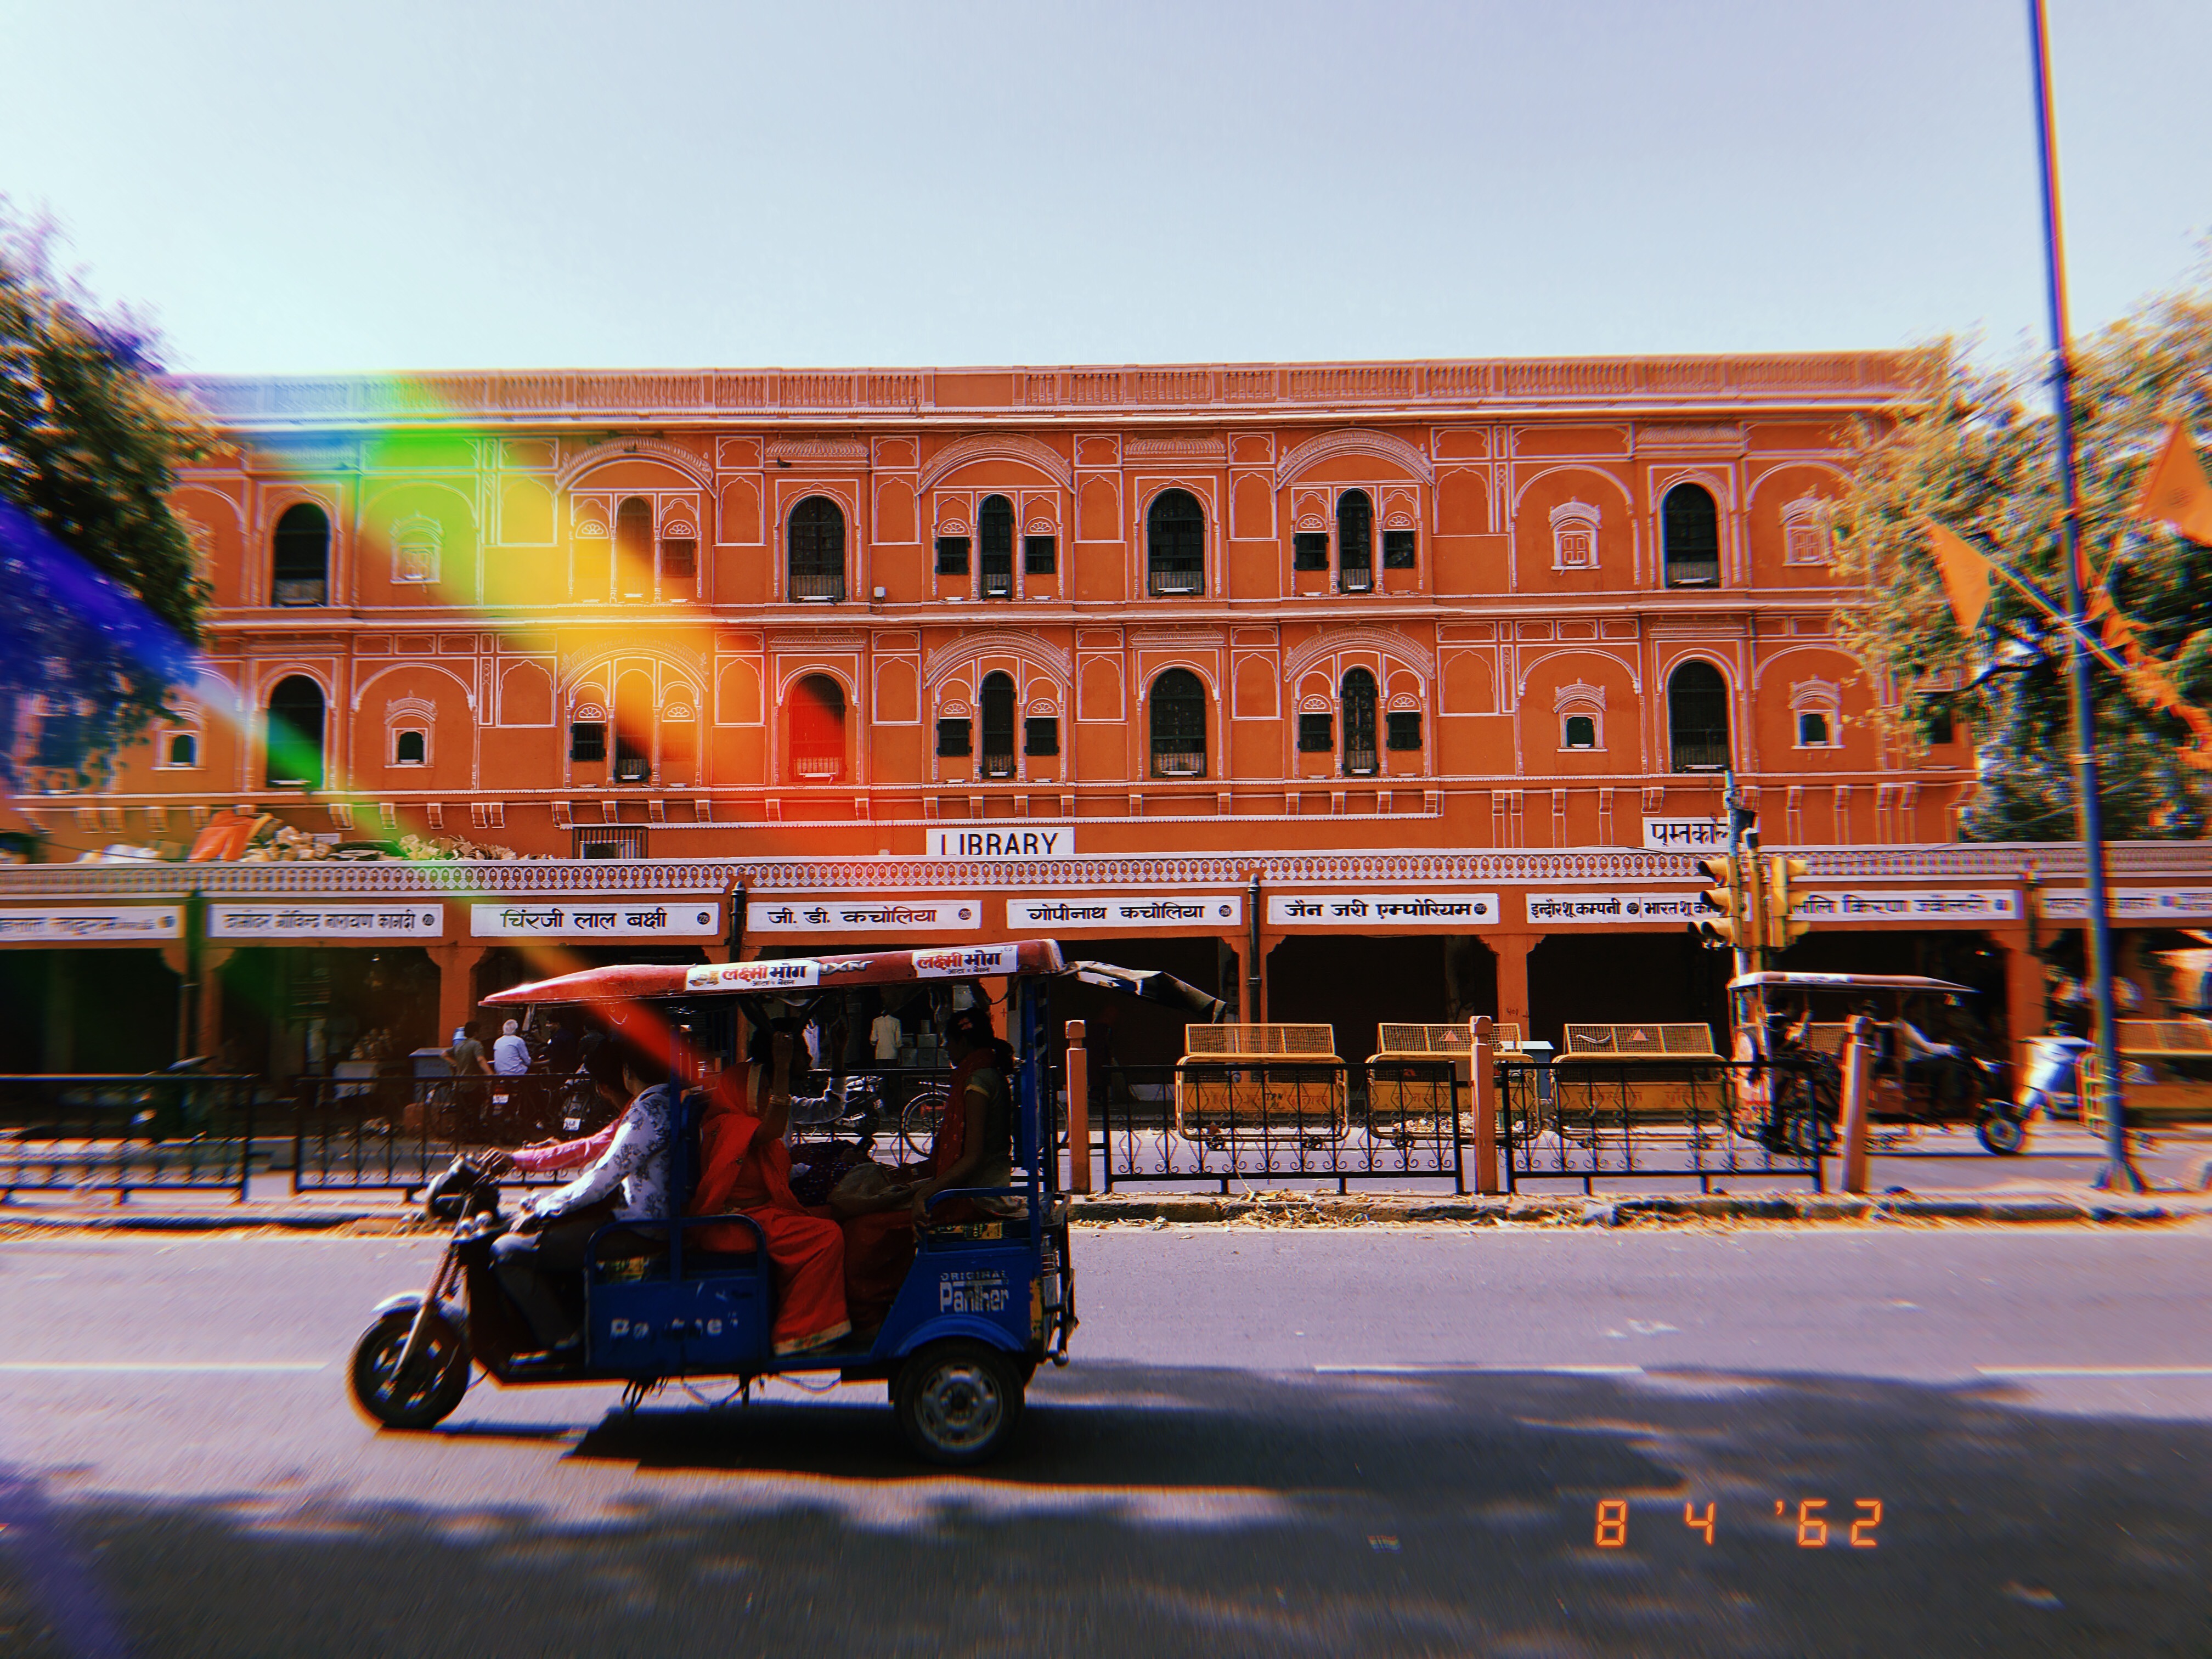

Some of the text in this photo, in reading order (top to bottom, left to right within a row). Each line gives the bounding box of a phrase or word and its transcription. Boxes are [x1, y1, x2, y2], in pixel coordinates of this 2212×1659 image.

[941, 833, 1059, 855] LIBRARY
[766, 907, 797, 924] जी.
[803, 907, 830, 924] डी.
[840, 906, 938, 924] कचोलिया
[1026, 903, 1108, 921] गोपीनाथ
[1119, 902, 1206, 919] कचोलिया
[1284, 899, 1324, 917] जैन
[1330, 899, 1369, 917] जरी
[1375, 899, 1472, 919] एम्पोरियम
[1576, 898, 1621, 915] कम्पनी
[1644, 901, 1679, 915] भारत
[573, 912, 618, 929] लाल
[625, 907, 668, 929] बक्षी
[917, 950, 1002, 970] लक्ष्मी भोग
[721, 962, 808, 982] लक्ष्मी भोग
